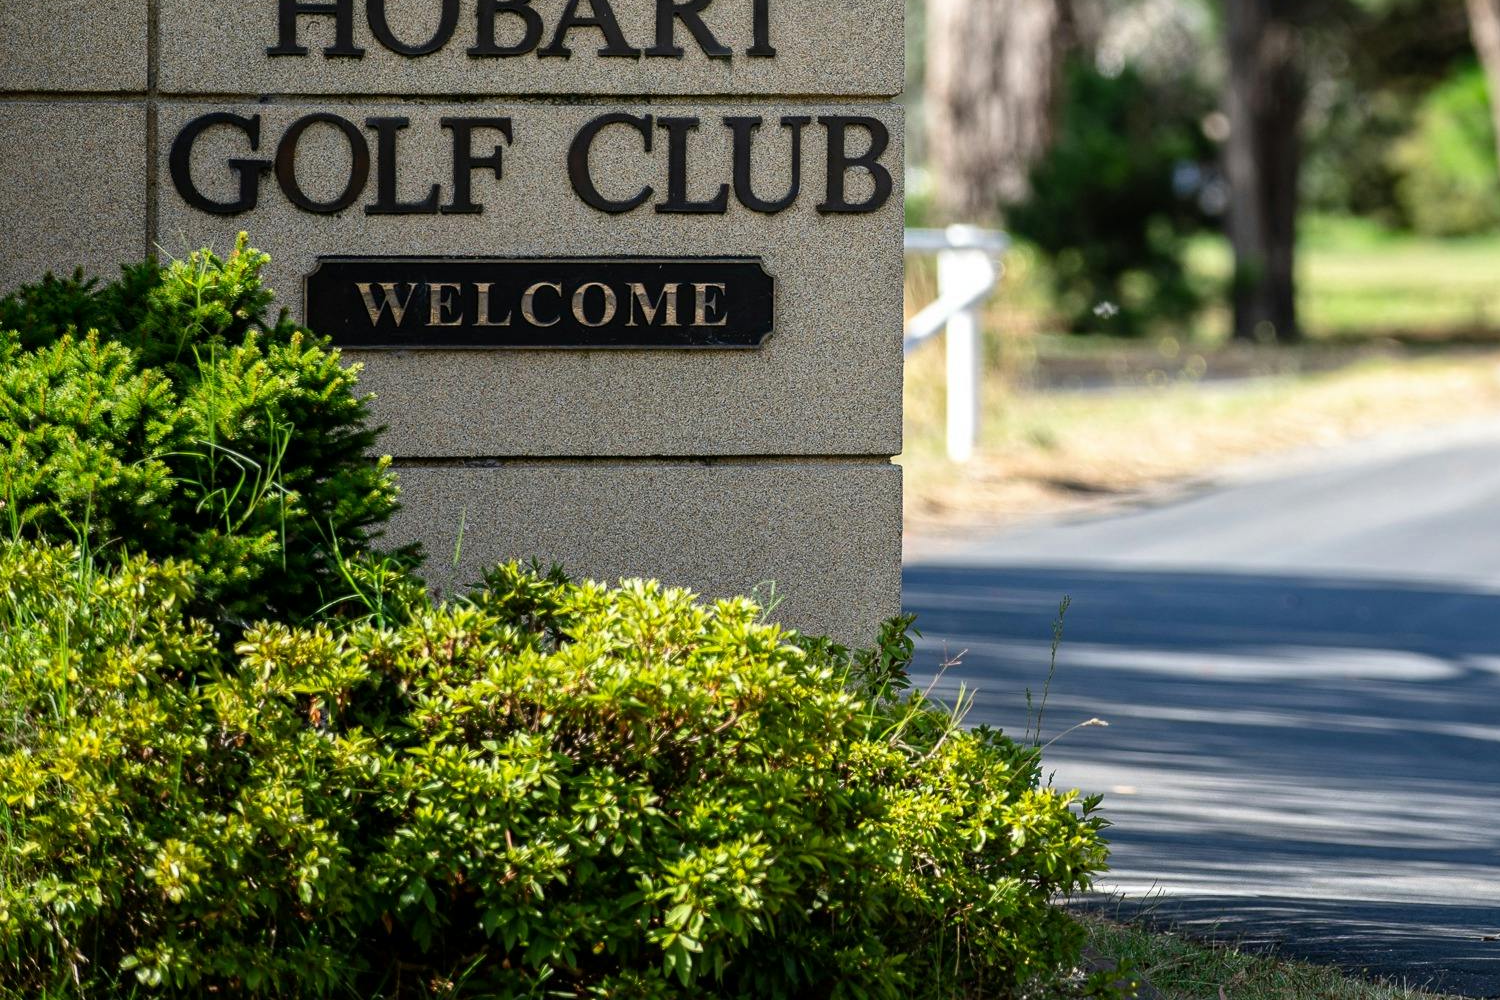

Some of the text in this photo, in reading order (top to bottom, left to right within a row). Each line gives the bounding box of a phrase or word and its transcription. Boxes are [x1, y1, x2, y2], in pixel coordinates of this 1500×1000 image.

[168, 112, 894, 216] GOLF CLUB
[355, 281, 729, 329] WELCOME
